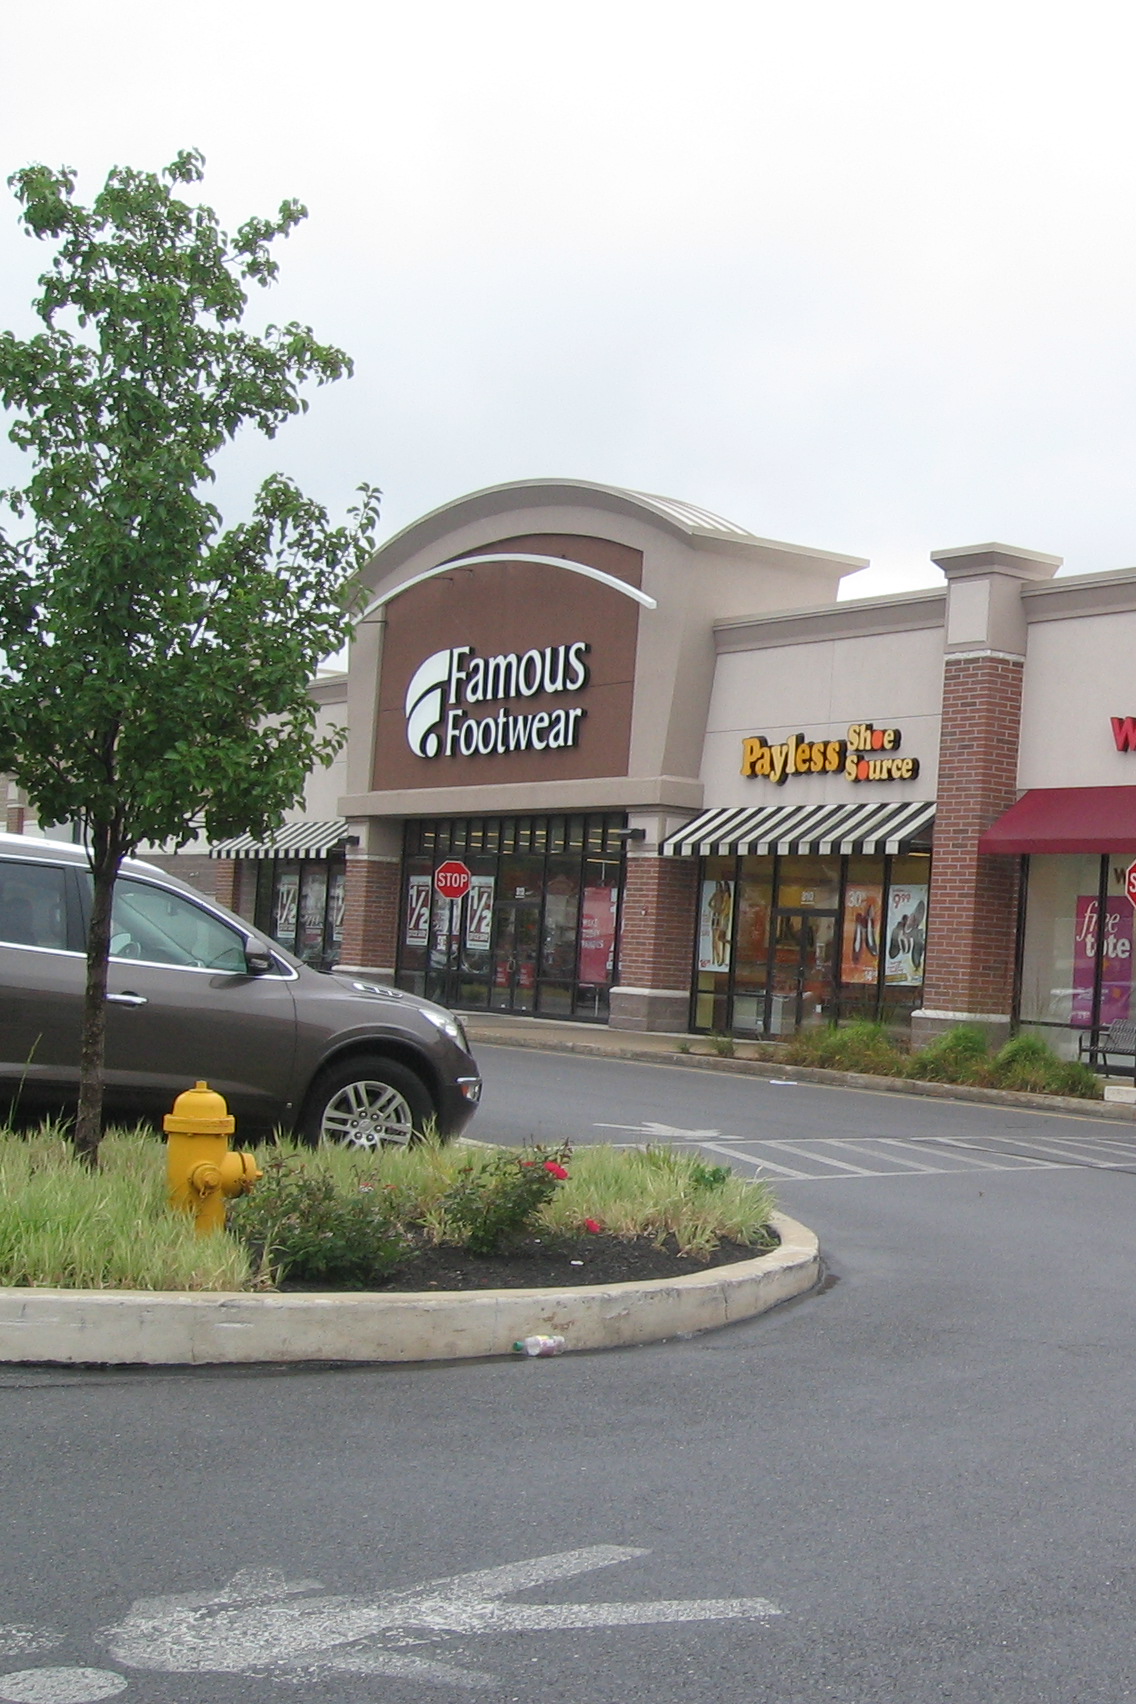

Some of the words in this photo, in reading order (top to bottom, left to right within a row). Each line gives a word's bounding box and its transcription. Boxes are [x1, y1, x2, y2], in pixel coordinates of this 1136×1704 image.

[448, 642, 591, 704] Famous
[444, 707, 584, 757] Footwear
[847, 723, 900, 752] Shoe
[740, 732, 845, 785] Payless
[845, 755, 919, 782] Source
[437, 872, 468, 888] STOP
[409, 885, 430, 930] 1/2
[469, 886, 492, 933] 1/2
[1076, 900, 1120, 942] fre
[1085, 932, 1131, 959] tte
